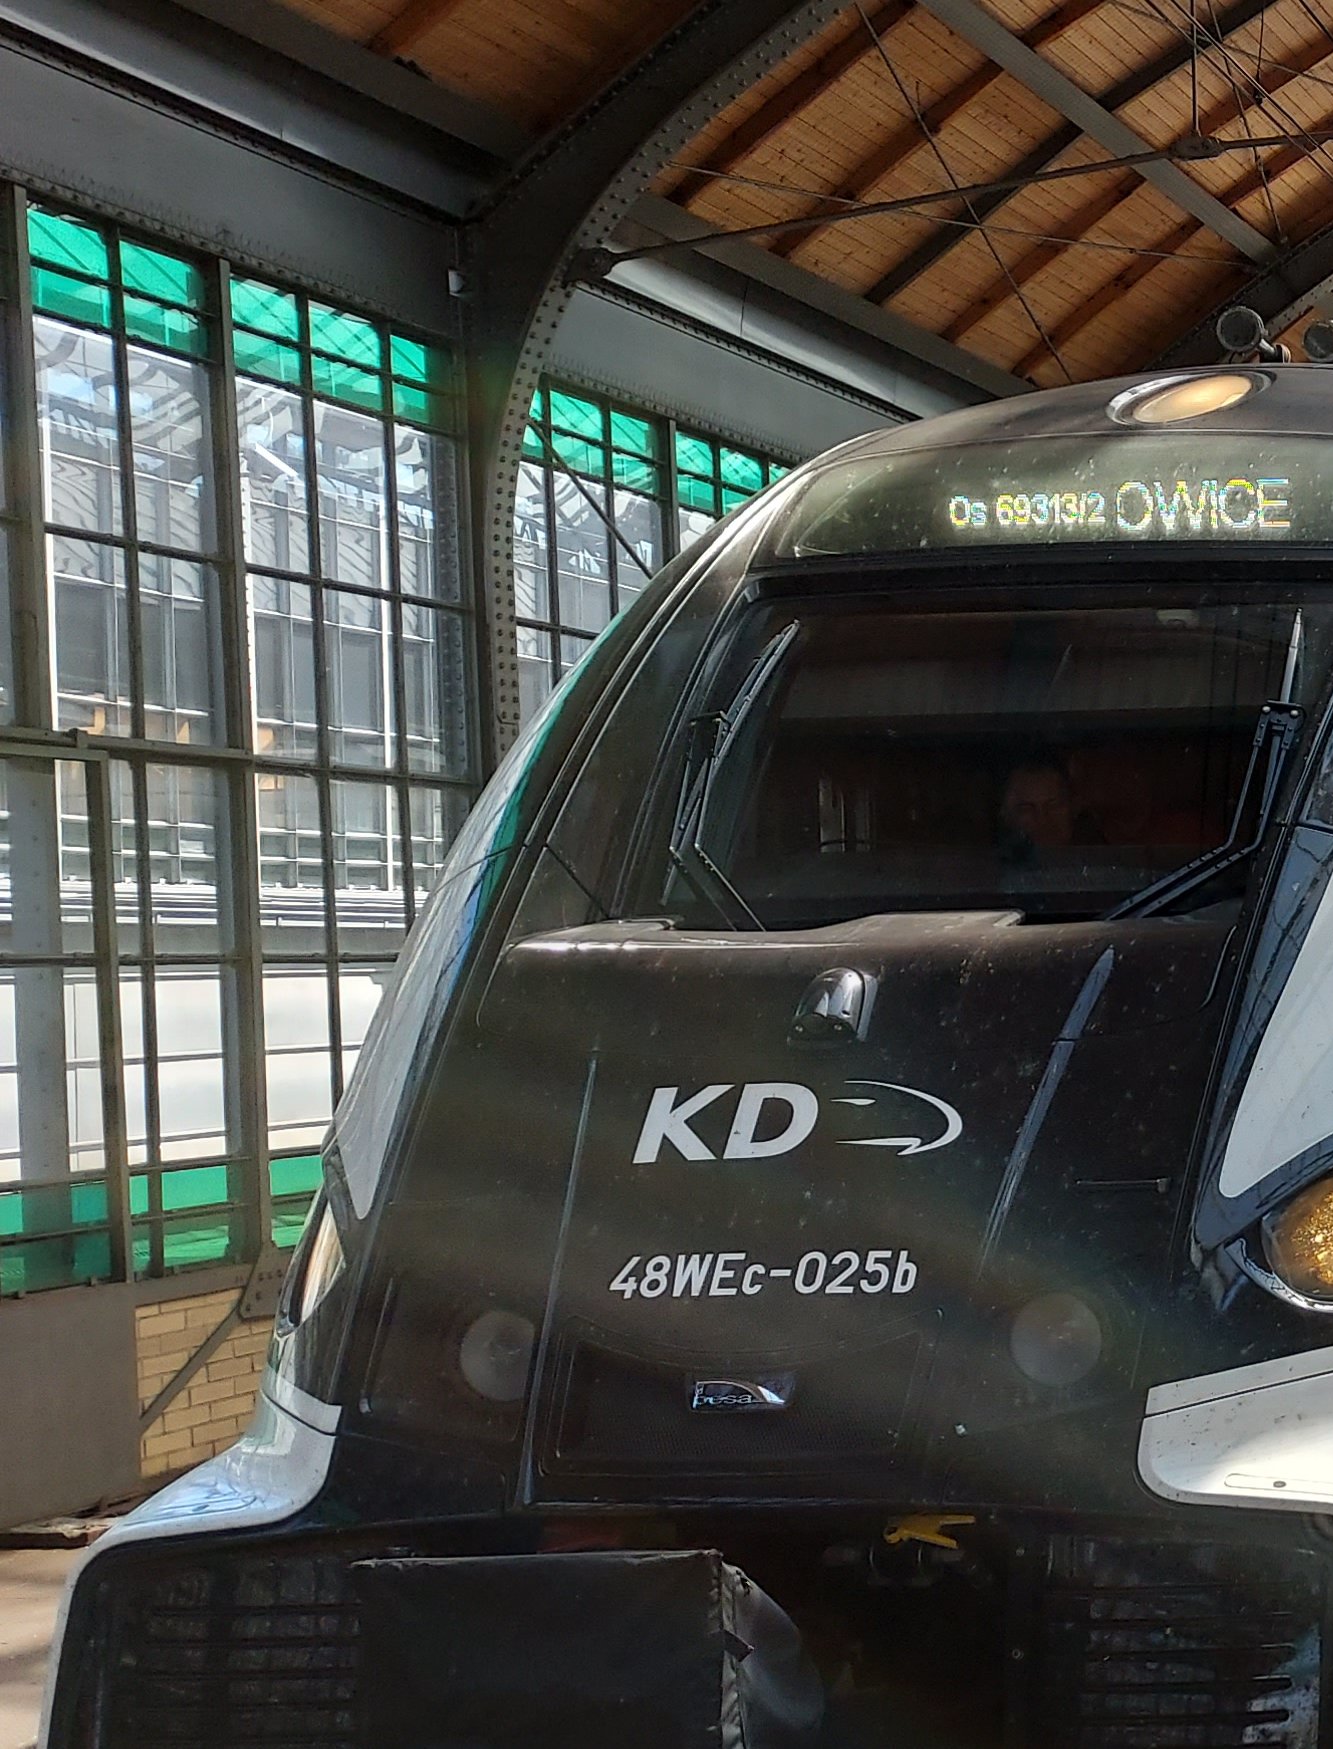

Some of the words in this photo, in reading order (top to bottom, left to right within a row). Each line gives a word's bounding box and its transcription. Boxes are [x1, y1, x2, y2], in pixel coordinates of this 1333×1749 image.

[1116, 478, 1291, 531] OWICE
[632, 1082, 819, 1165] KD
[609, 1250, 918, 1299] 48WEc-025b
